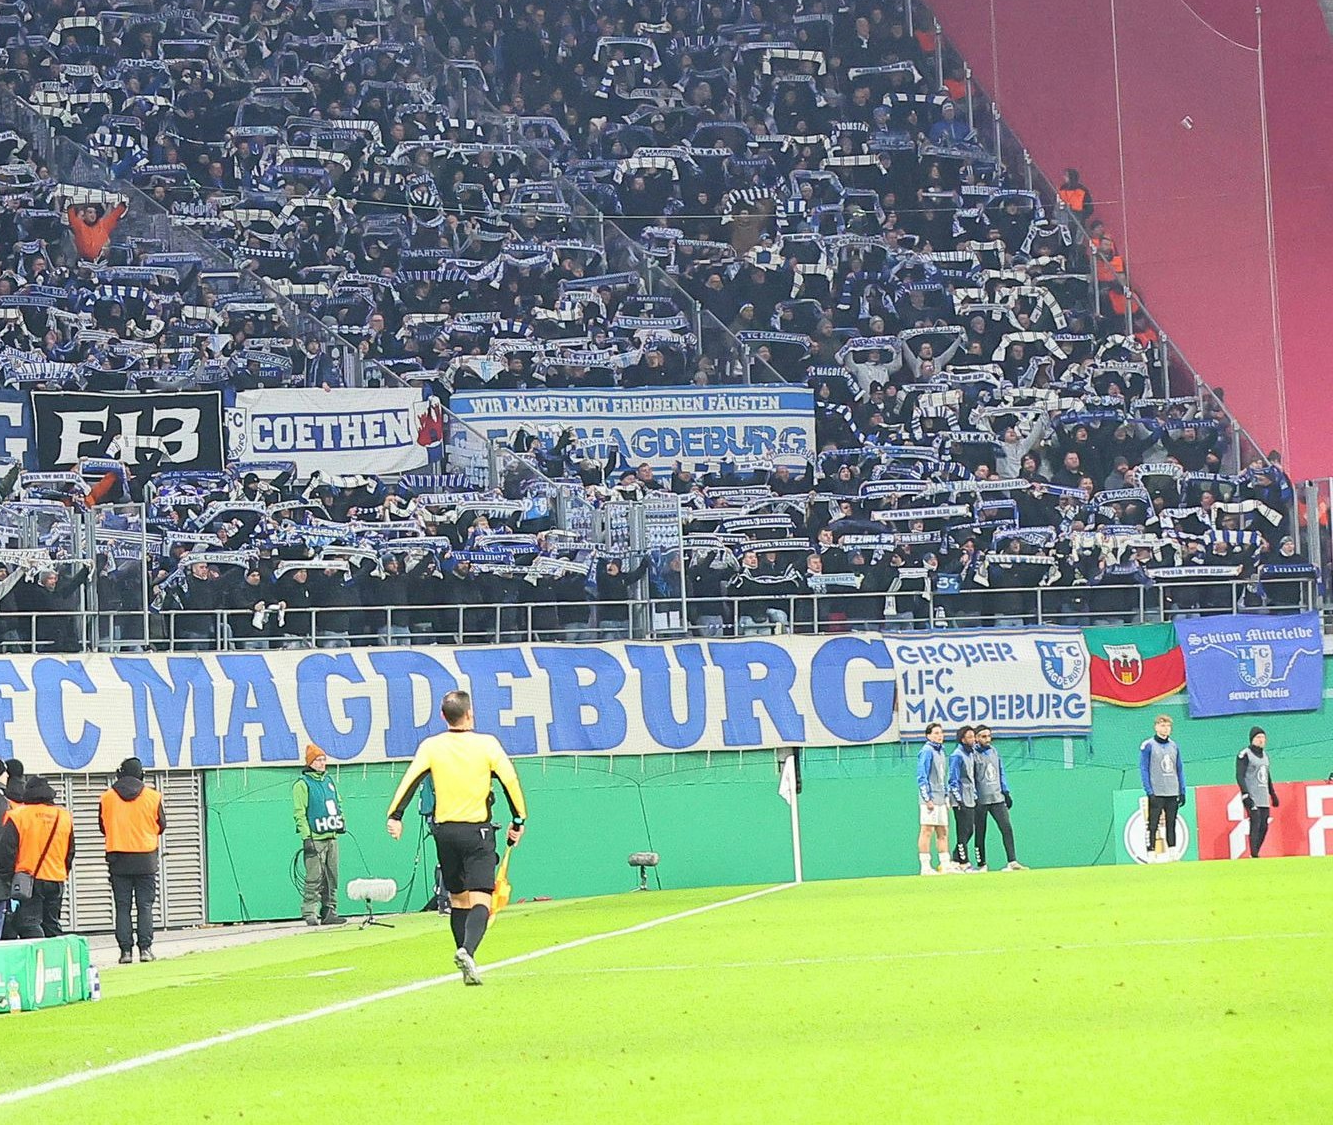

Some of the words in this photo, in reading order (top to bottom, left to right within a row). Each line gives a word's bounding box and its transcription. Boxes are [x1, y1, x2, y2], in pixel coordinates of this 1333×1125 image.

[470, 397, 504, 413] WIR
[508, 394, 578, 413] KÄMPFEN
[581, 396, 609, 413] MIT
[612, 396, 704, 412] ERHOBENEN
[707, 393, 780, 411] FÄUSTEN
[251, 410, 410, 452] COETHEN
[577, 424, 808, 470] MAGDEBURG
[843, 533, 879, 544] BEZIRK
[470, 552, 506, 562] immer
[496, 546, 535, 555] immer
[1187, 630, 1242, 647] Sektion
[1245, 626, 1314, 643] Mittelelbe
[902, 668, 954, 695] 1.FC
[116, 637, 896, 768] MAGDEBURG
[1228, 688, 1259, 702] semper
[905, 692, 1087, 724] MAGDEBURG
